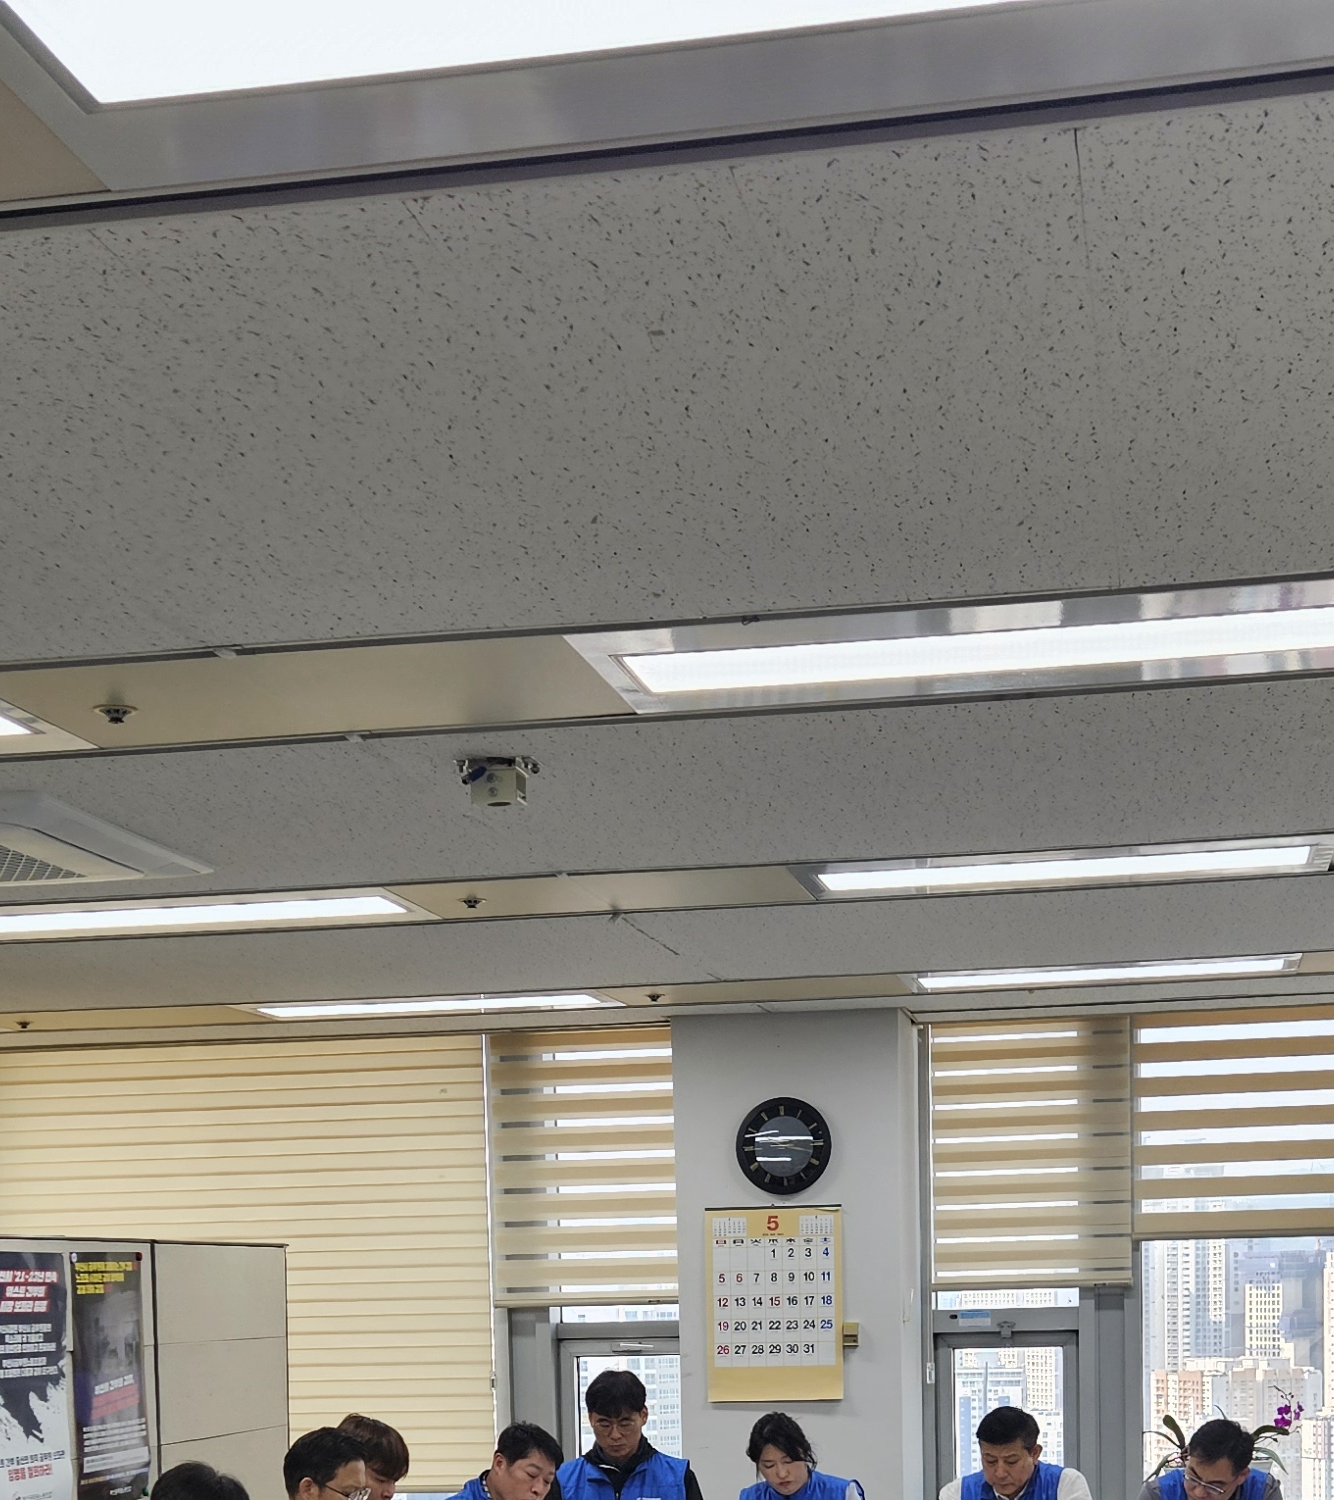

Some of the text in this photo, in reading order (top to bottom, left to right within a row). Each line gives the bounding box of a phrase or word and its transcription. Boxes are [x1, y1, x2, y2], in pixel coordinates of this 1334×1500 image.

[766, 1215, 779, 1231] 5
[771, 1247, 829, 1258] 1 2 3 4
[719, 1271, 831, 1283] 5 6 7 8 9 10 11
[717, 1295, 832, 1307] 12 13 14 15 16 17 18
[718, 1320, 833, 1331] 19 20 21 22 23 24 25
[717, 1344, 815, 1354] 26 27 28 29 30 31
